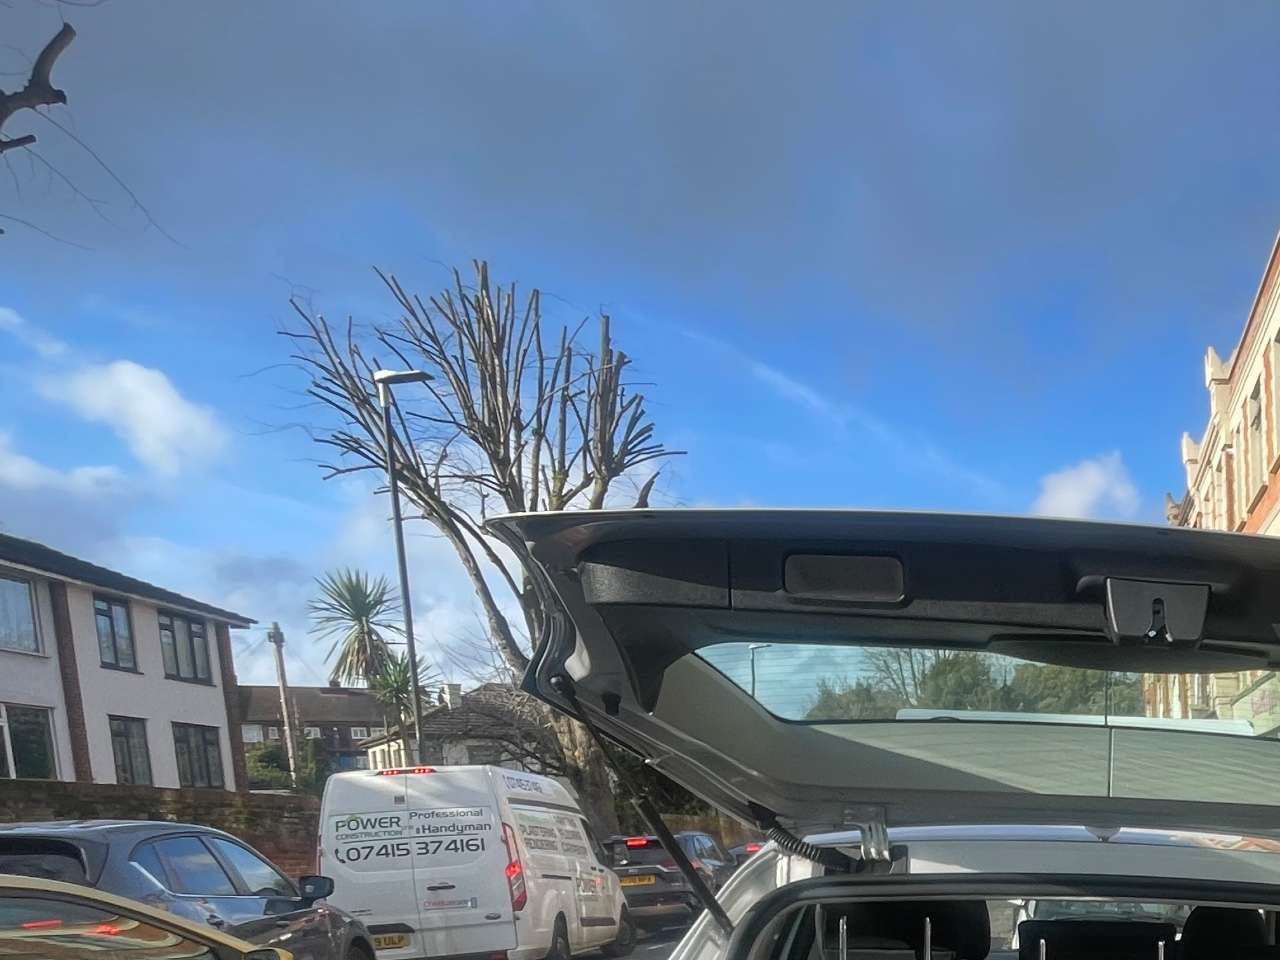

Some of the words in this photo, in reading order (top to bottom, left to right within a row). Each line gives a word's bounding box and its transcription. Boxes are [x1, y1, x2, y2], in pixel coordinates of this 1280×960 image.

[409, 808, 483, 820] Professional
[335, 815, 401, 833] POWER
[422, 823, 492, 834] Handyman
[335, 830, 403, 840] CONSTRUCTION
[346, 843, 410, 862] 07415
[416, 838, 485, 856] 374161
